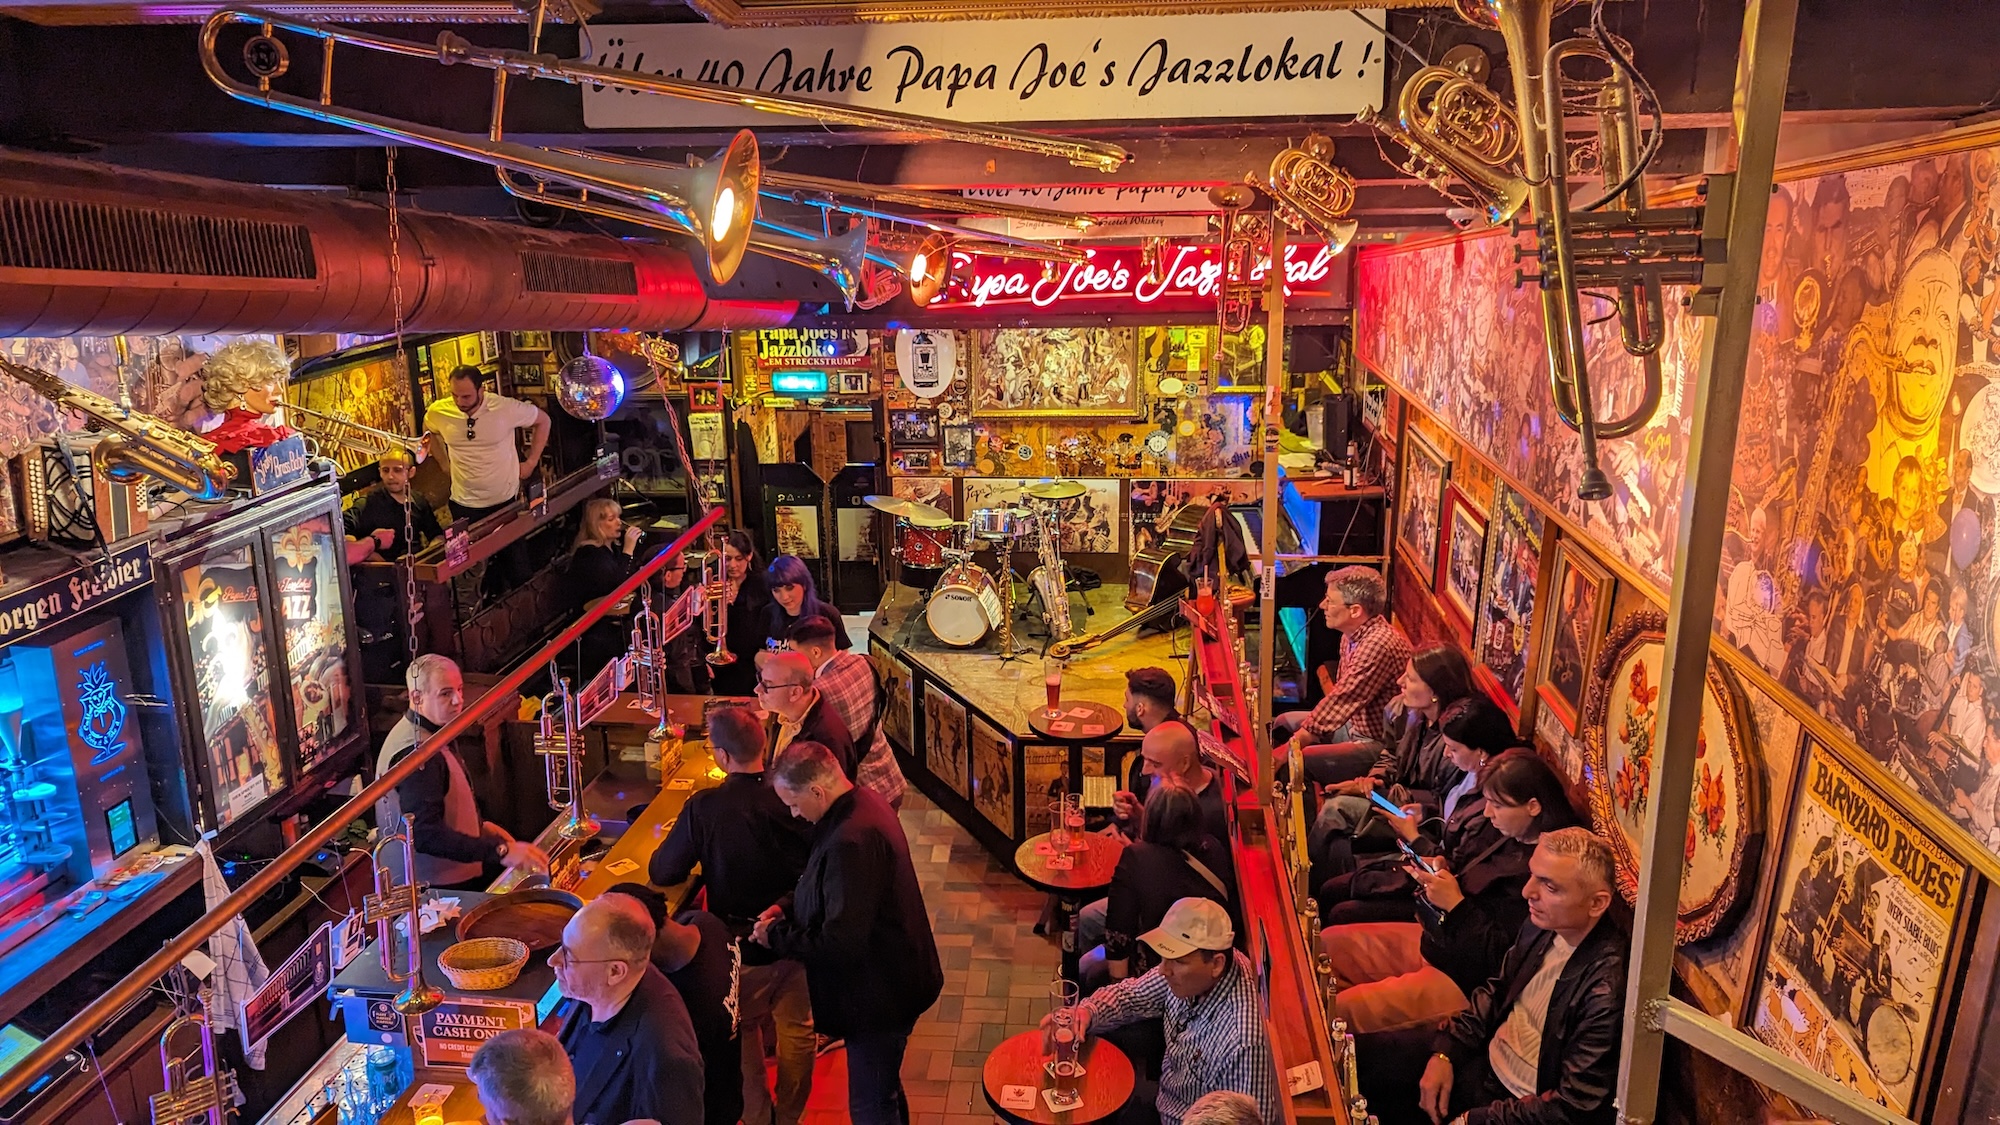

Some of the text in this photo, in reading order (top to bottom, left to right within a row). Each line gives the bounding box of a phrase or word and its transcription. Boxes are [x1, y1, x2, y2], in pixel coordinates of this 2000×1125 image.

[699, 59, 744, 89] 40
[756, 48, 873, 94] Jahre
[887, 44, 995, 109] Papa
[1128, 37, 1342, 97] Jazzlokal
[760, 340, 832, 360] Jazzloka
[950, 594, 973, 602] SONOR
[1912, 830, 1934, 855] Jazz
[1934, 848, 1957, 873] Band
[435, 1012, 506, 1027] PAYMENT
[432, 1026, 471, 1039] CASH
[448, 1043, 465, 1051] CREDIT
